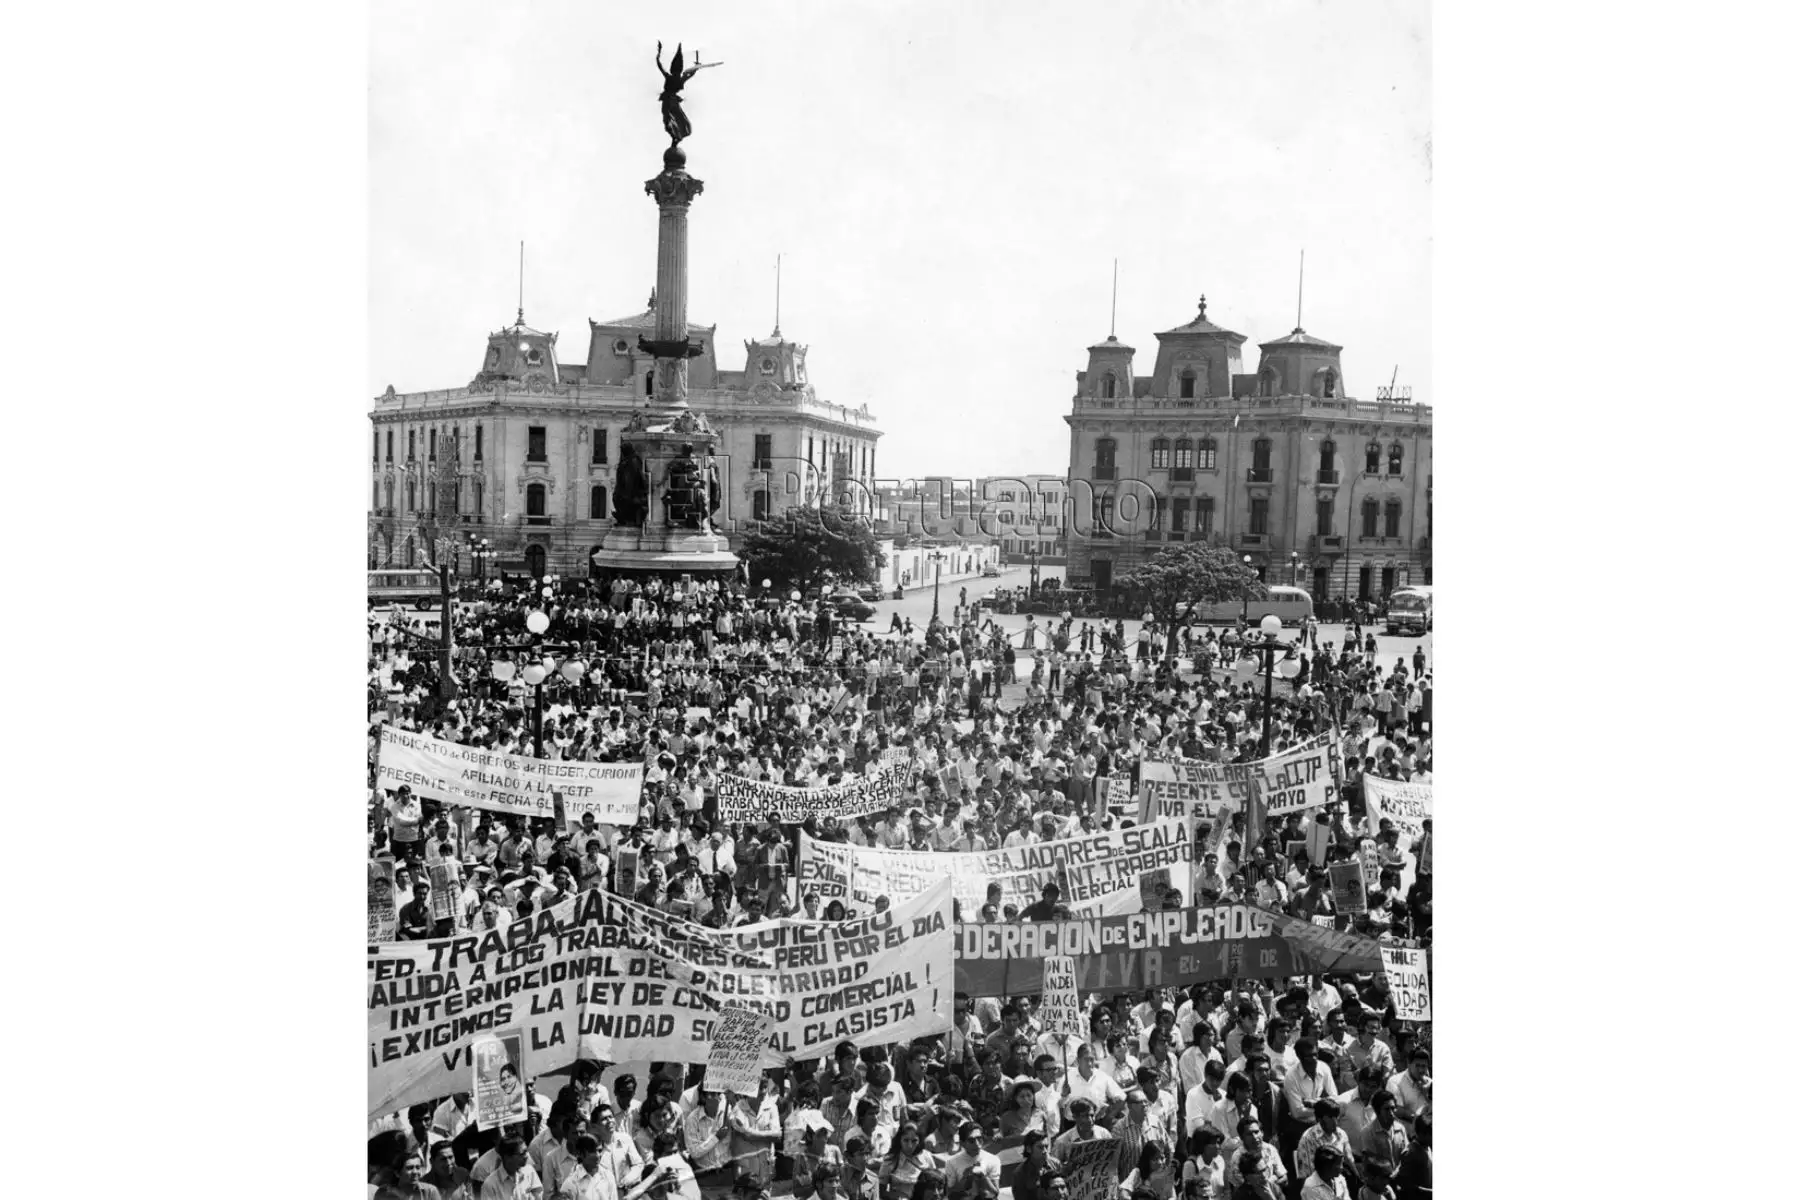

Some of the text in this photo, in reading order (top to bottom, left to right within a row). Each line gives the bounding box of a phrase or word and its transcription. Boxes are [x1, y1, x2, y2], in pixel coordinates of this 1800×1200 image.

[382, 729, 448, 756] SINDICATO
[462, 750, 520, 770] OBREROS
[524, 763, 536, 773] de
[379, 765, 446, 792] PRESENTE
[490, 790, 531, 806] FECHA
[462, 768, 520, 789] AFILIADO
[525, 780, 532, 793] A
[538, 781, 555, 794] LA
[1185, 761, 1265, 783] SIMILARES
[1264, 773, 1287, 792] LA
[1193, 802, 1217, 818] EL
[1267, 788, 1306, 811] MAYO
[1112, 843, 1126, 857] DE
[1123, 822, 1188, 849] SCALA
[1100, 843, 1193, 879] TRABAJO
[1102, 925, 1126, 945] DE
[1127, 904, 1279, 949] EMPLEADOS
[370, 971, 461, 1009] ALUDA
[469, 963, 487, 985] A
[495, 943, 546, 974] LOS
[775, 943, 828, 969] PERU
[834, 935, 880, 962] POR
[884, 925, 910, 949] EL
[912, 911, 945, 938] DIA
[1074, 950, 1164, 990] VIVA
[1179, 956, 1200, 974] EL
[1260, 948, 1279, 968] DE
[390, 956, 868, 1030] INTERNACIONAL DEL PROLETARIADO
[531, 987, 564, 1015] LA
[576, 982, 626, 1006] LEY
[632, 983, 667, 1006] DE
[801, 972, 918, 1017] COMERCIAL
[1051, 994, 1062, 1007] LA
[531, 1021, 566, 1050] LA
[578, 1014, 675, 1039] UNIDAD
[804, 999, 915, 1045] CLASISTA
[1042, 1008, 1078, 1021] VIVA EL
[1045, 1020, 1058, 1032] DE
[711, 1041, 762, 1053] BORALES
